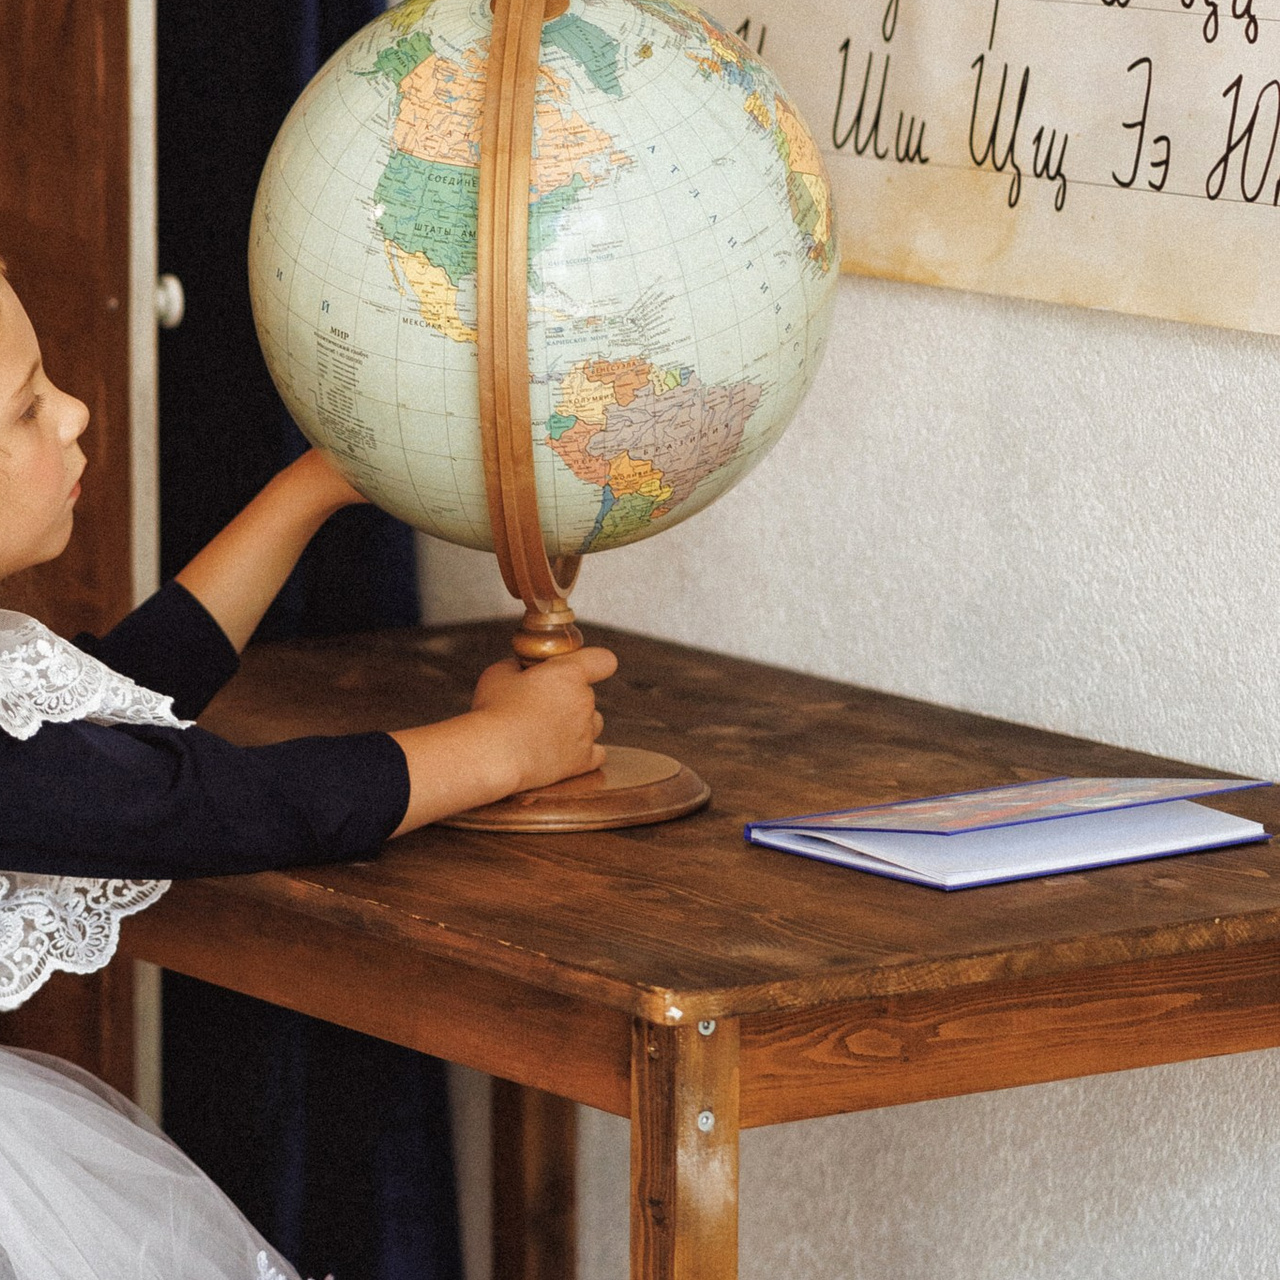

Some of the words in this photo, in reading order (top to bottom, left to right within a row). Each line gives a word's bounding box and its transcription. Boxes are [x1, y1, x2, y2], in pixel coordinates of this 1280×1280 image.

[832, 37, 929, 165] Шш
[969, 54, 1068, 212] Щщ
[1112, 57, 1171, 192] Ээ
[1205, 74, 1280, 207] Ю
[427, 173, 478, 188] СОЕДИНЕ
[414, 223, 452, 236] ШТАТЫ
[402, 317, 442, 330] МЕКСИКА
[330, 325, 350, 341] МИР
[590, 334, 609, 343] МОРЕ
[591, 361, 637, 374] ВЕНЕСУЭЛА
[568, 393, 615, 405] КОЛУМБИЯ
[643, 422, 729, 456] БРАЗИЛИЯ
[573, 457, 600, 465] ПЕРУ
